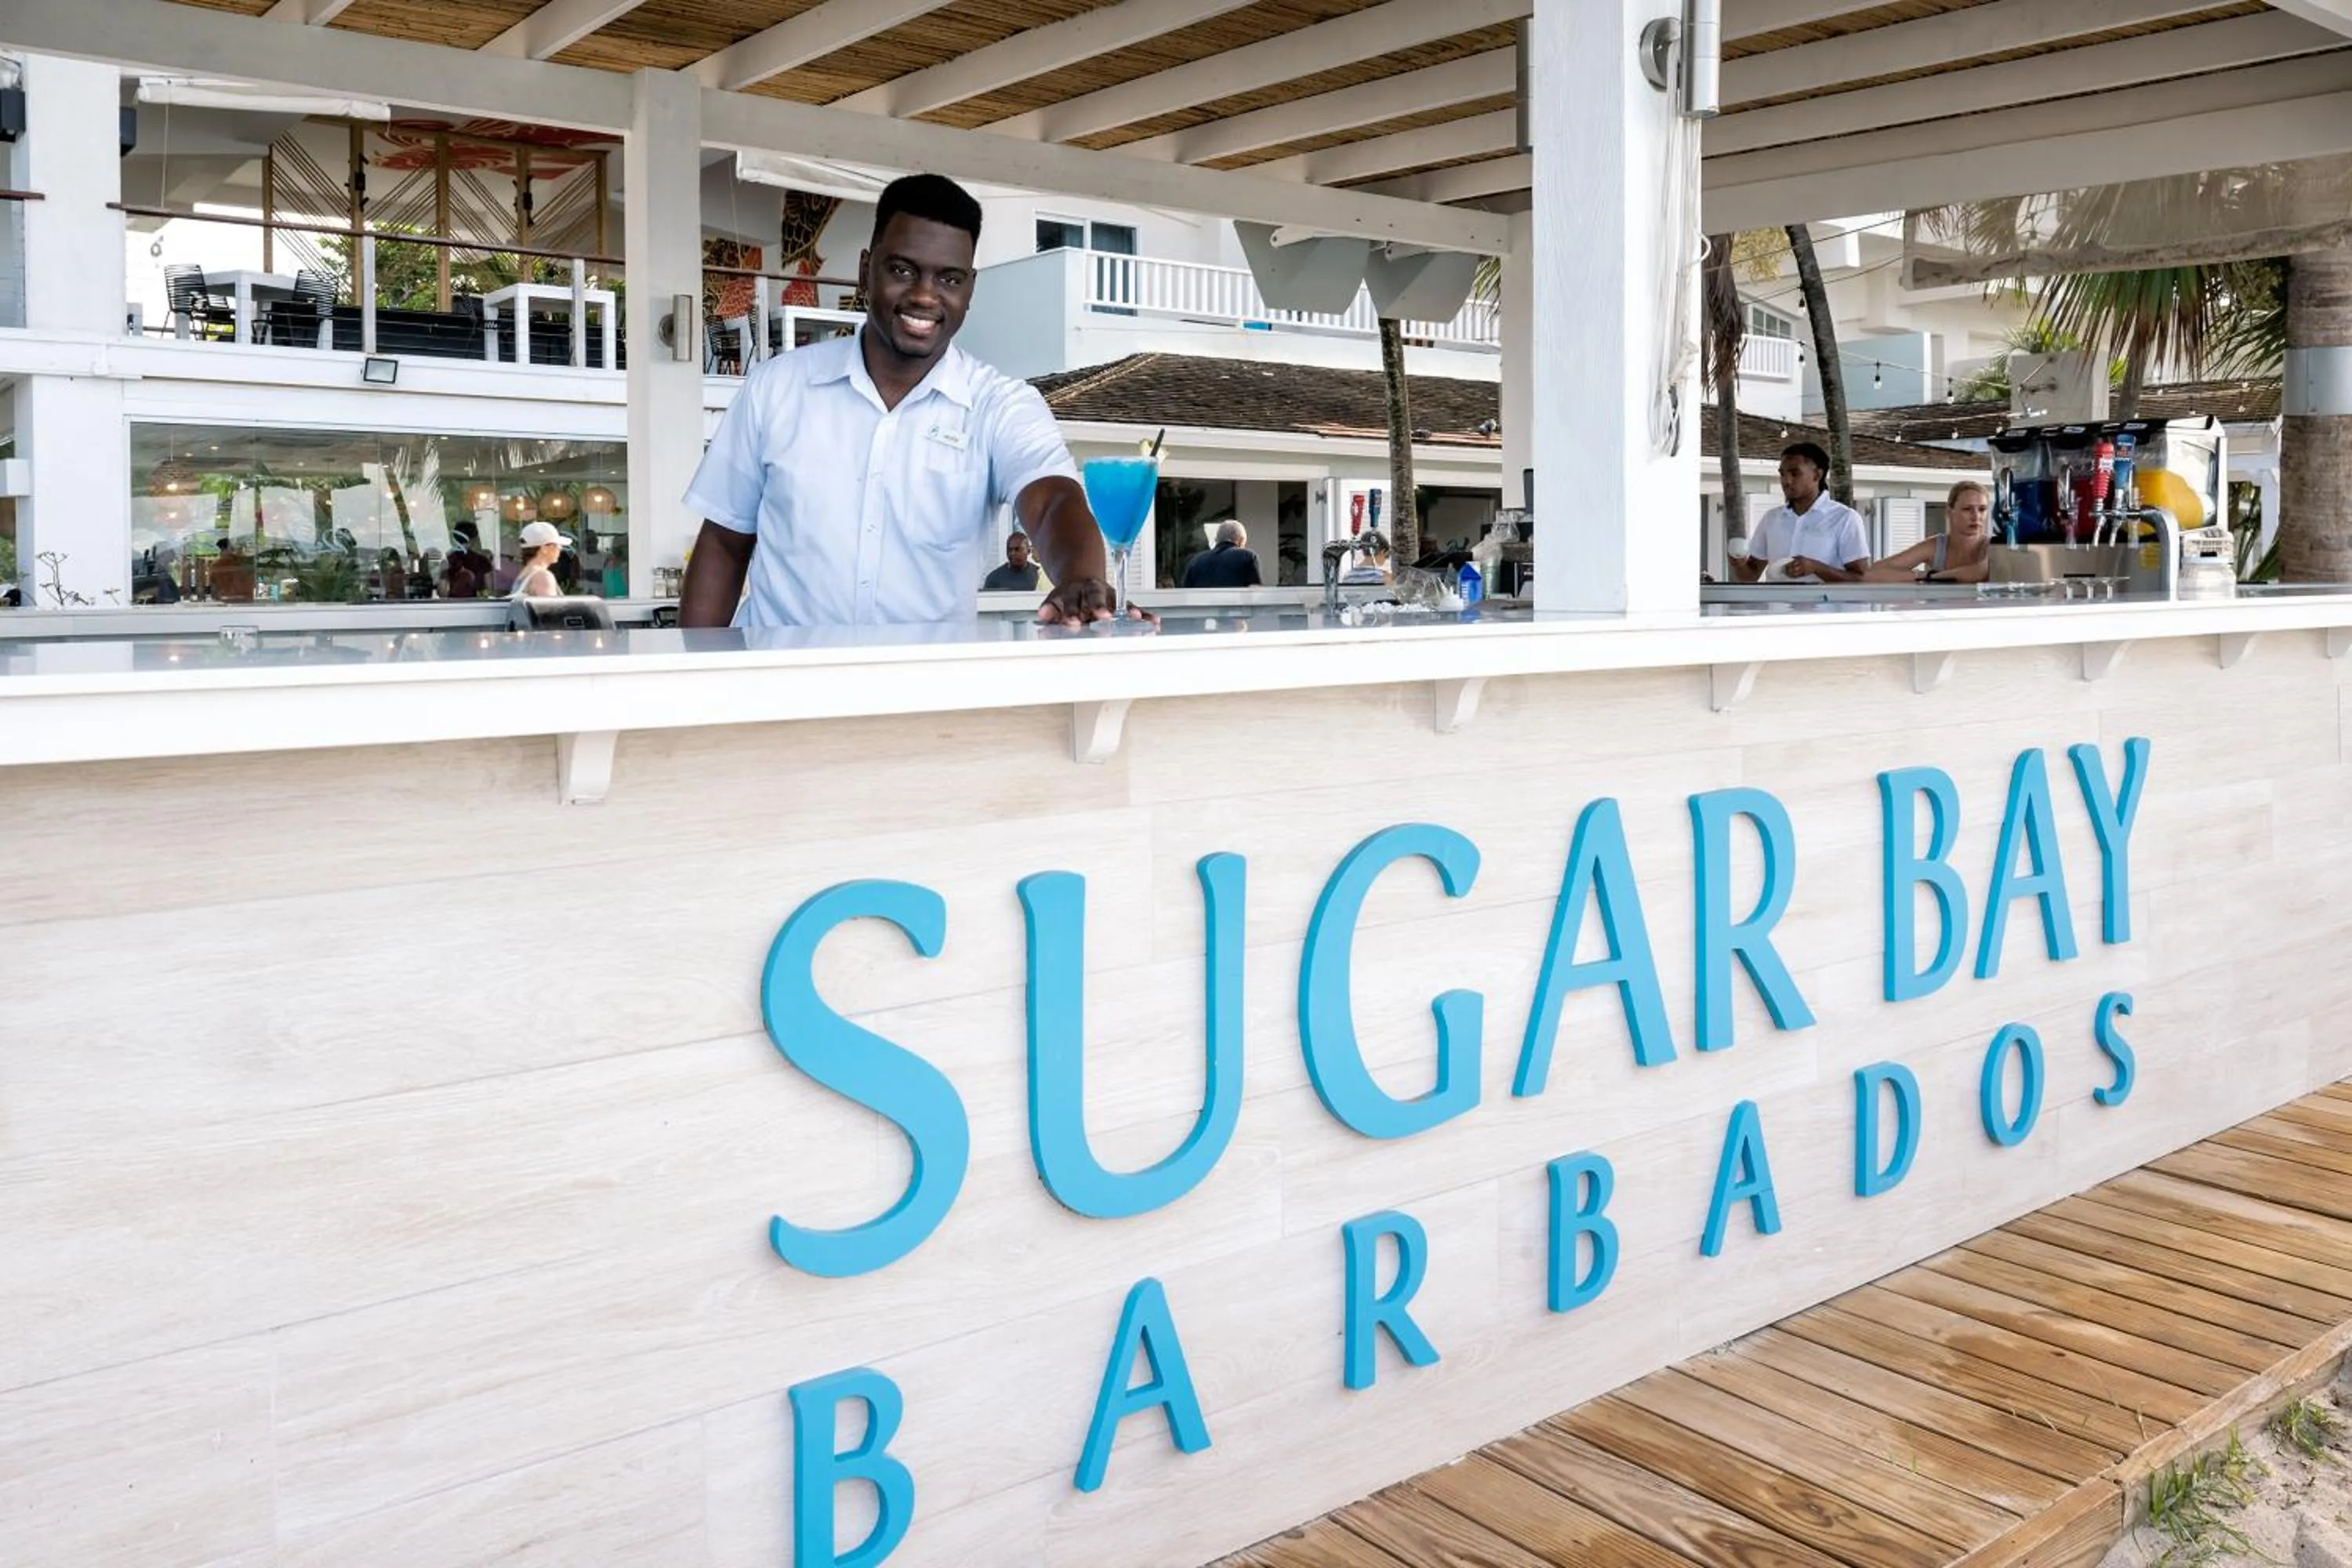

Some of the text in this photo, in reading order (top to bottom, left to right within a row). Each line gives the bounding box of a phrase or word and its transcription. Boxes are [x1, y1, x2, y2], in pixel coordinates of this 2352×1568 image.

[760, 737, 2149, 1277] SUGAR BAY
[788, 993, 2134, 1568] BARBADOS
